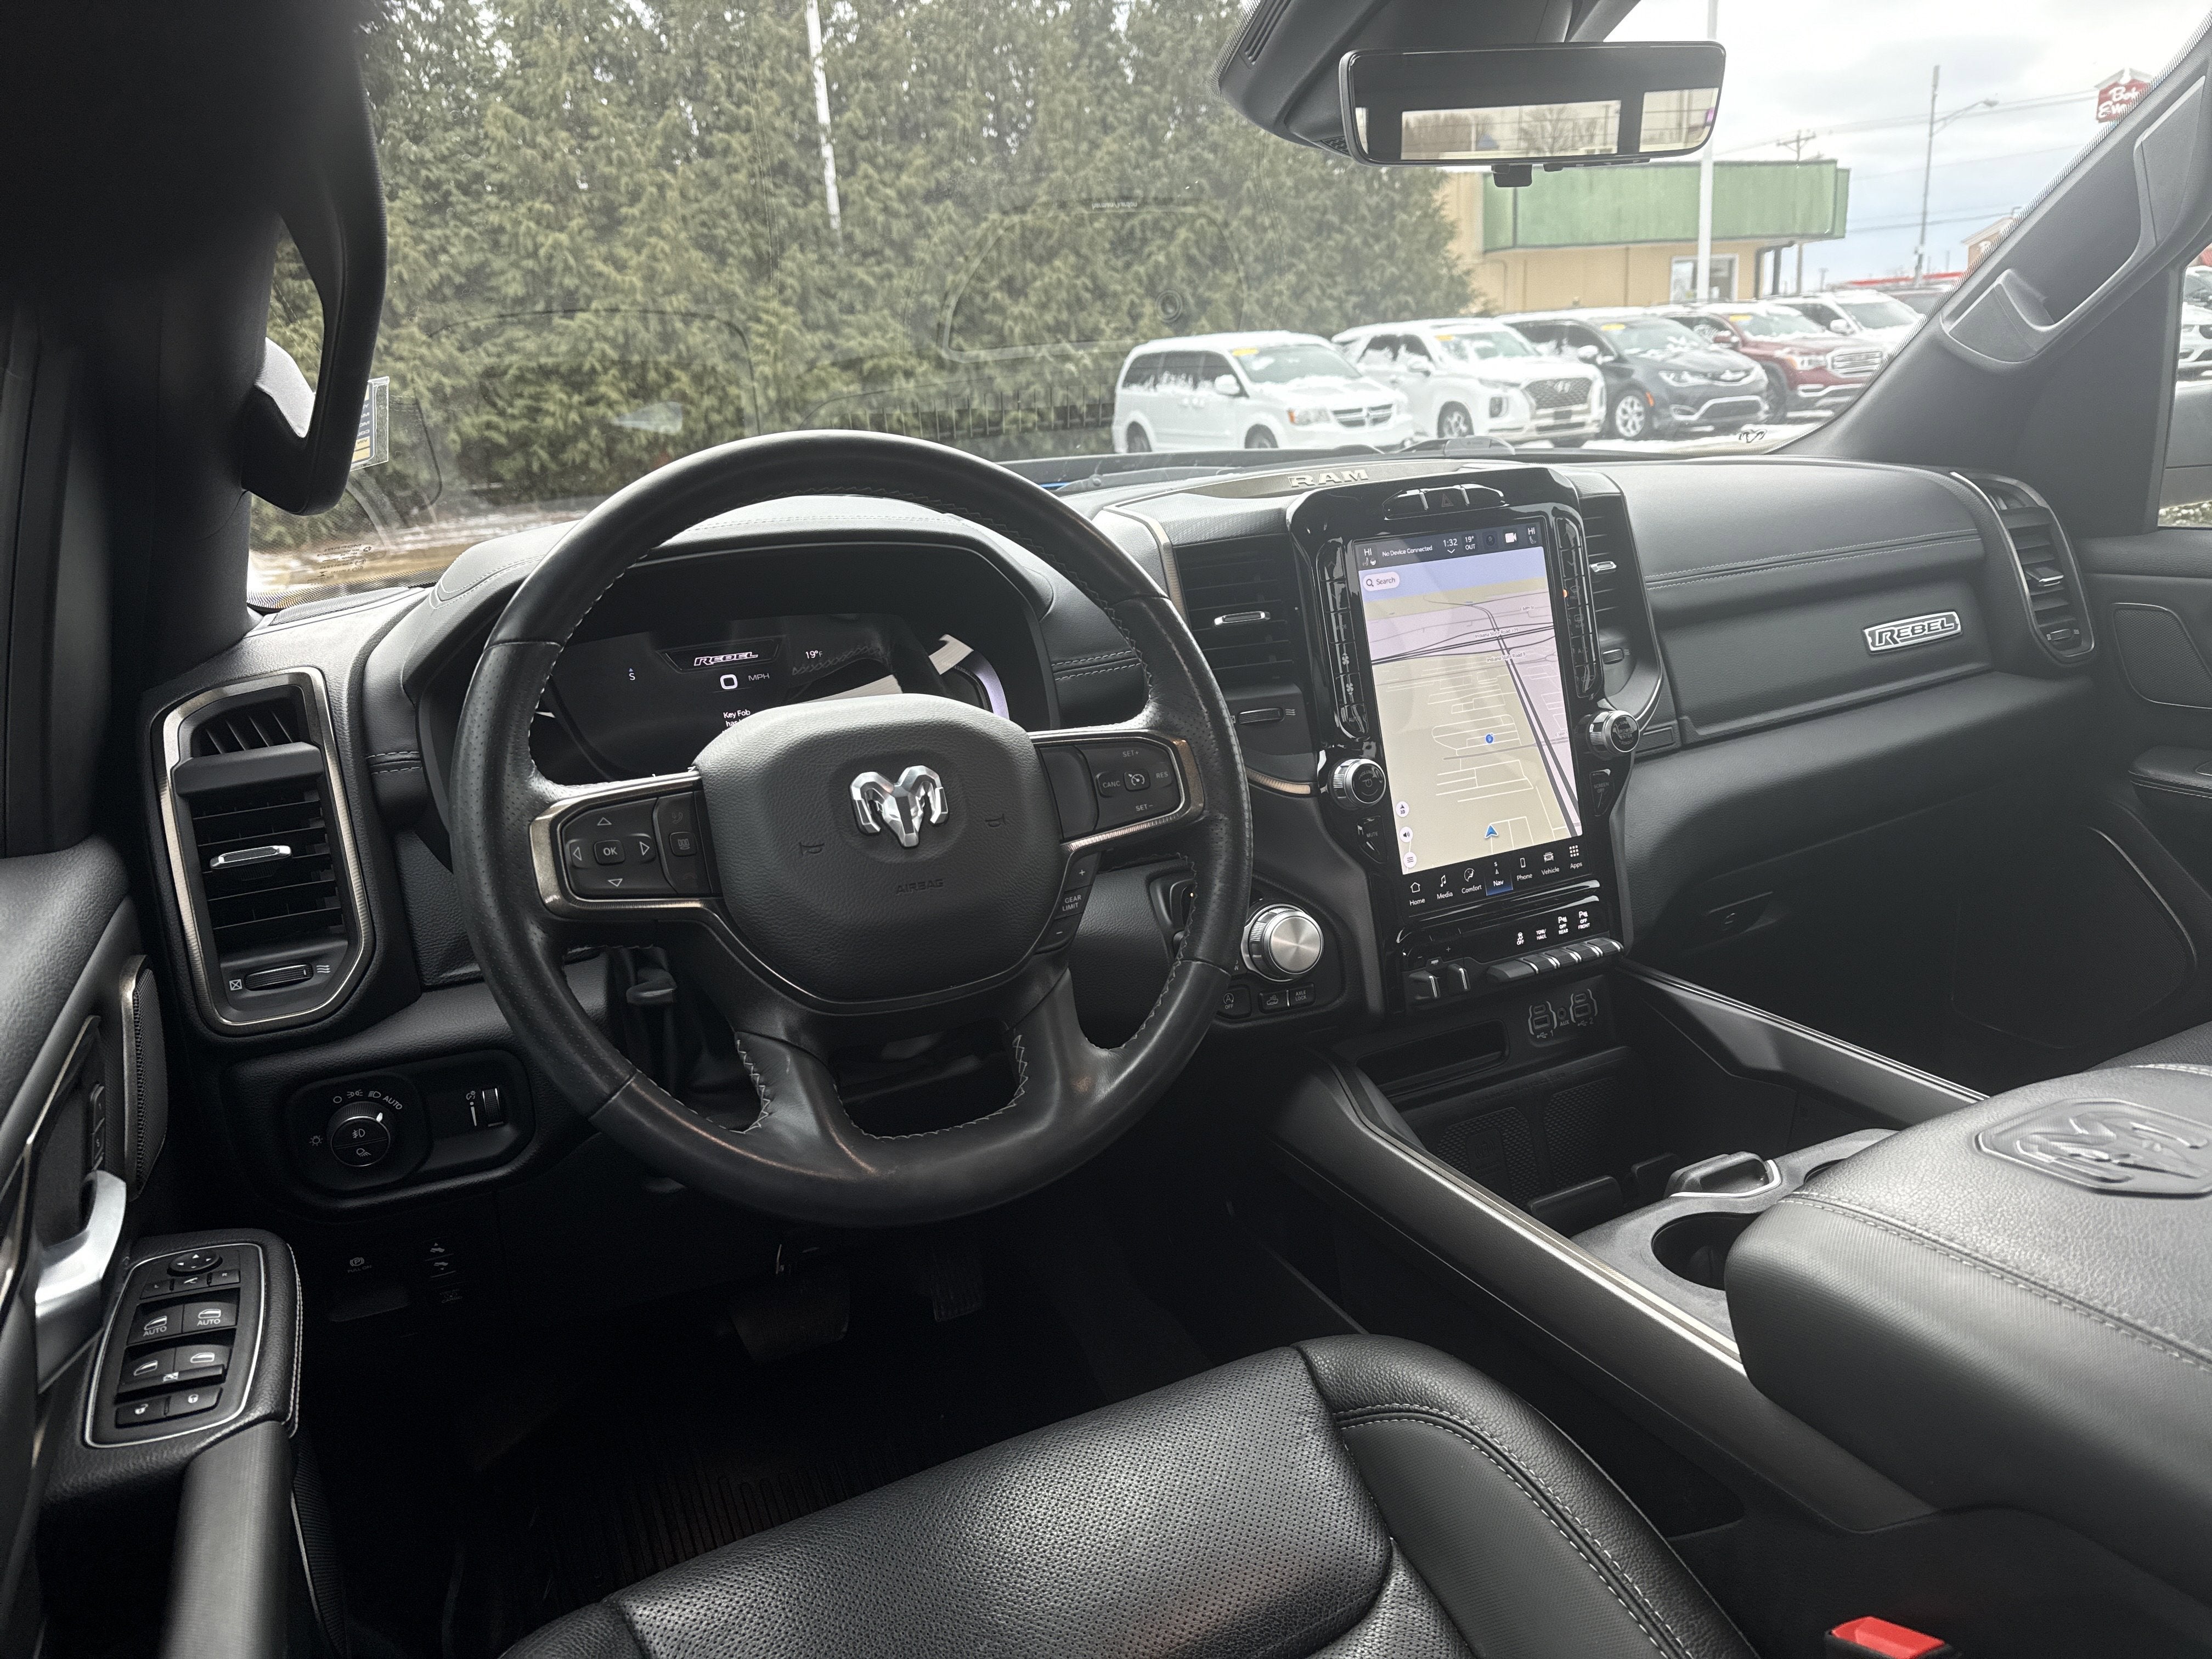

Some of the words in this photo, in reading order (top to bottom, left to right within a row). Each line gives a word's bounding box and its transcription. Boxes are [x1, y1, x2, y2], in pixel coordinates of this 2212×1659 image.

[1288, 469, 1369, 488] RAM
[1528, 527, 1536, 535] HI
[1443, 538, 1458, 548] 1:32
[1364, 548, 1372, 556] HI
[1407, 545, 1433, 554] Connected
[1376, 577, 1396, 585] Search
[1876, 618, 1955, 646] REBEL
[693, 651, 759, 667] REBEL
[805, 651, 823, 659] 19°F
[629, 673, 635, 681] S
[720, 674, 738, 690] 0
[748, 673, 770, 682] MPH
[1102, 780, 1121, 788] CANC
[603, 847, 618, 856] OK
[1541, 867, 1560, 876] Vehicle
[1516, 873, 1533, 882] Phone
[896, 878, 944, 895] AIRBAG
[1462, 884, 1482, 894] Comfort
[1064, 894, 1082, 904] GEAR
[1436, 891, 1453, 900] Media
[1062, 902, 1079, 911] LIMIT
[1409, 898, 1425, 906] Home
[382, 1096, 403, 1110] AUTO
[198, 1318, 221, 1327] AUTO
[143, 1326, 167, 1337] AUTO
